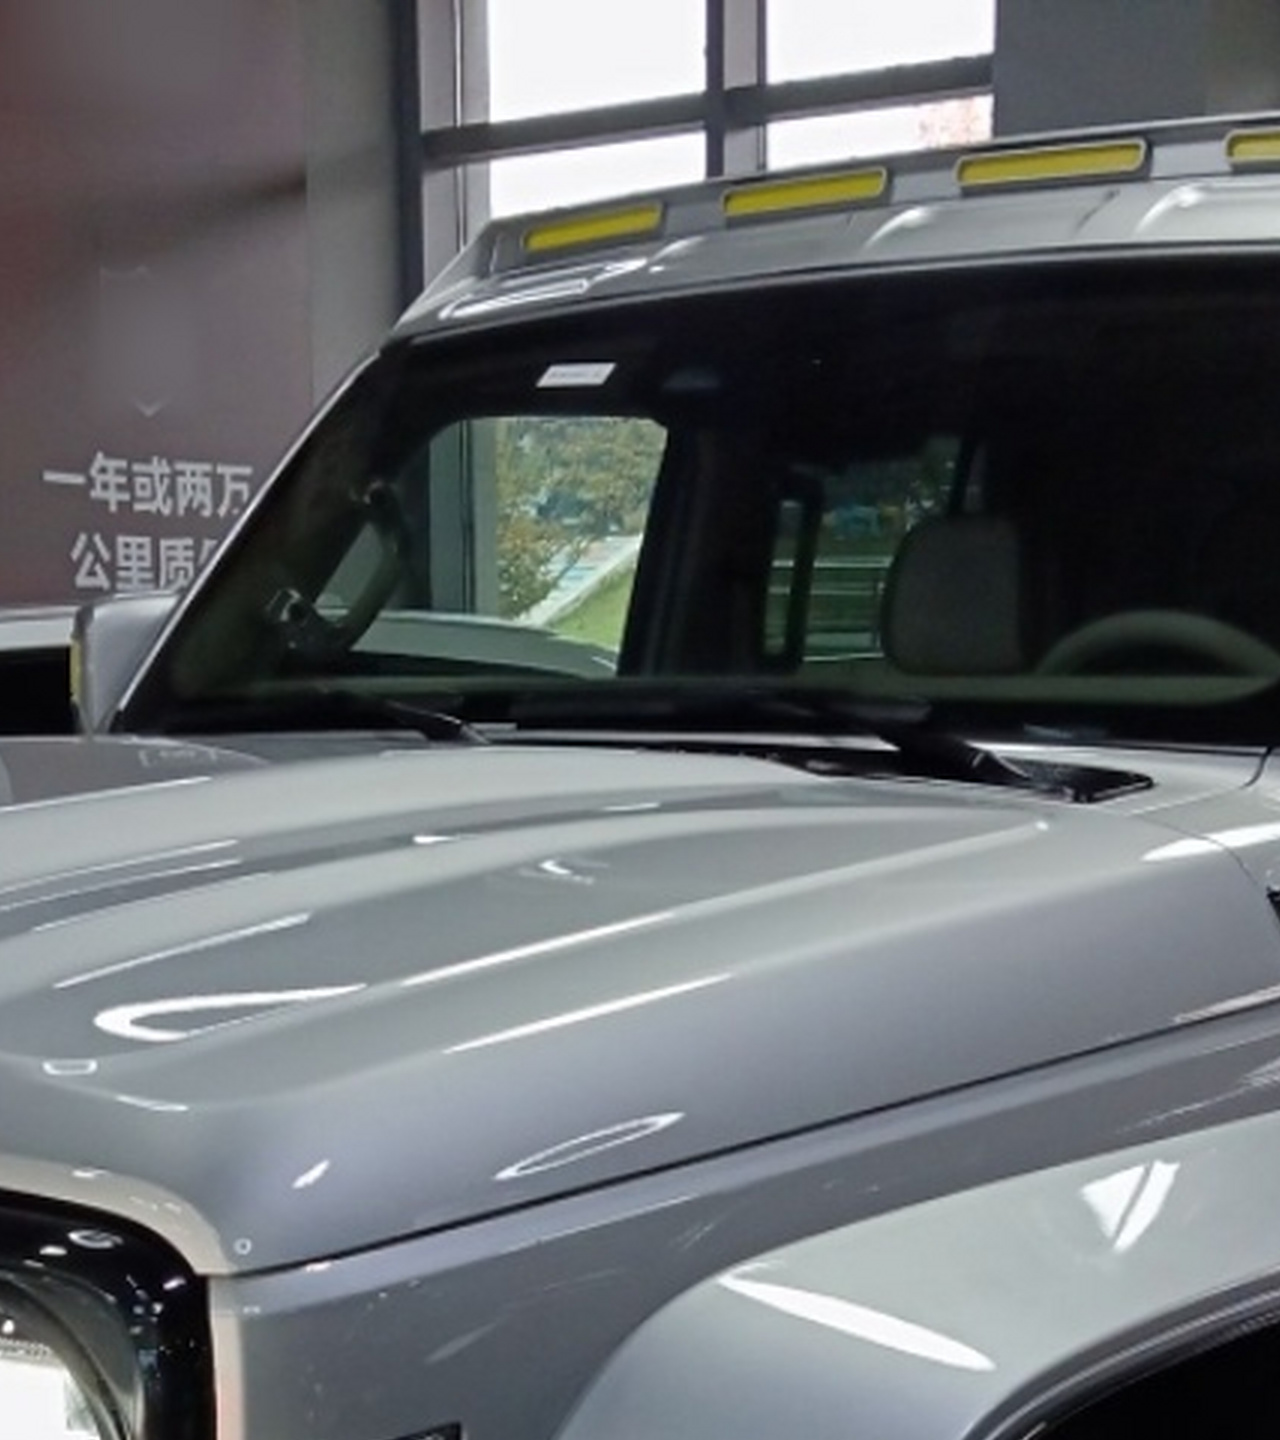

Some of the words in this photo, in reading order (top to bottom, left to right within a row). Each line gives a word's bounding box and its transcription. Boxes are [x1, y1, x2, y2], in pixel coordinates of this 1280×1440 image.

[42, 451, 253, 518] 一年或两万
[70, 533, 219, 592] 公里质
